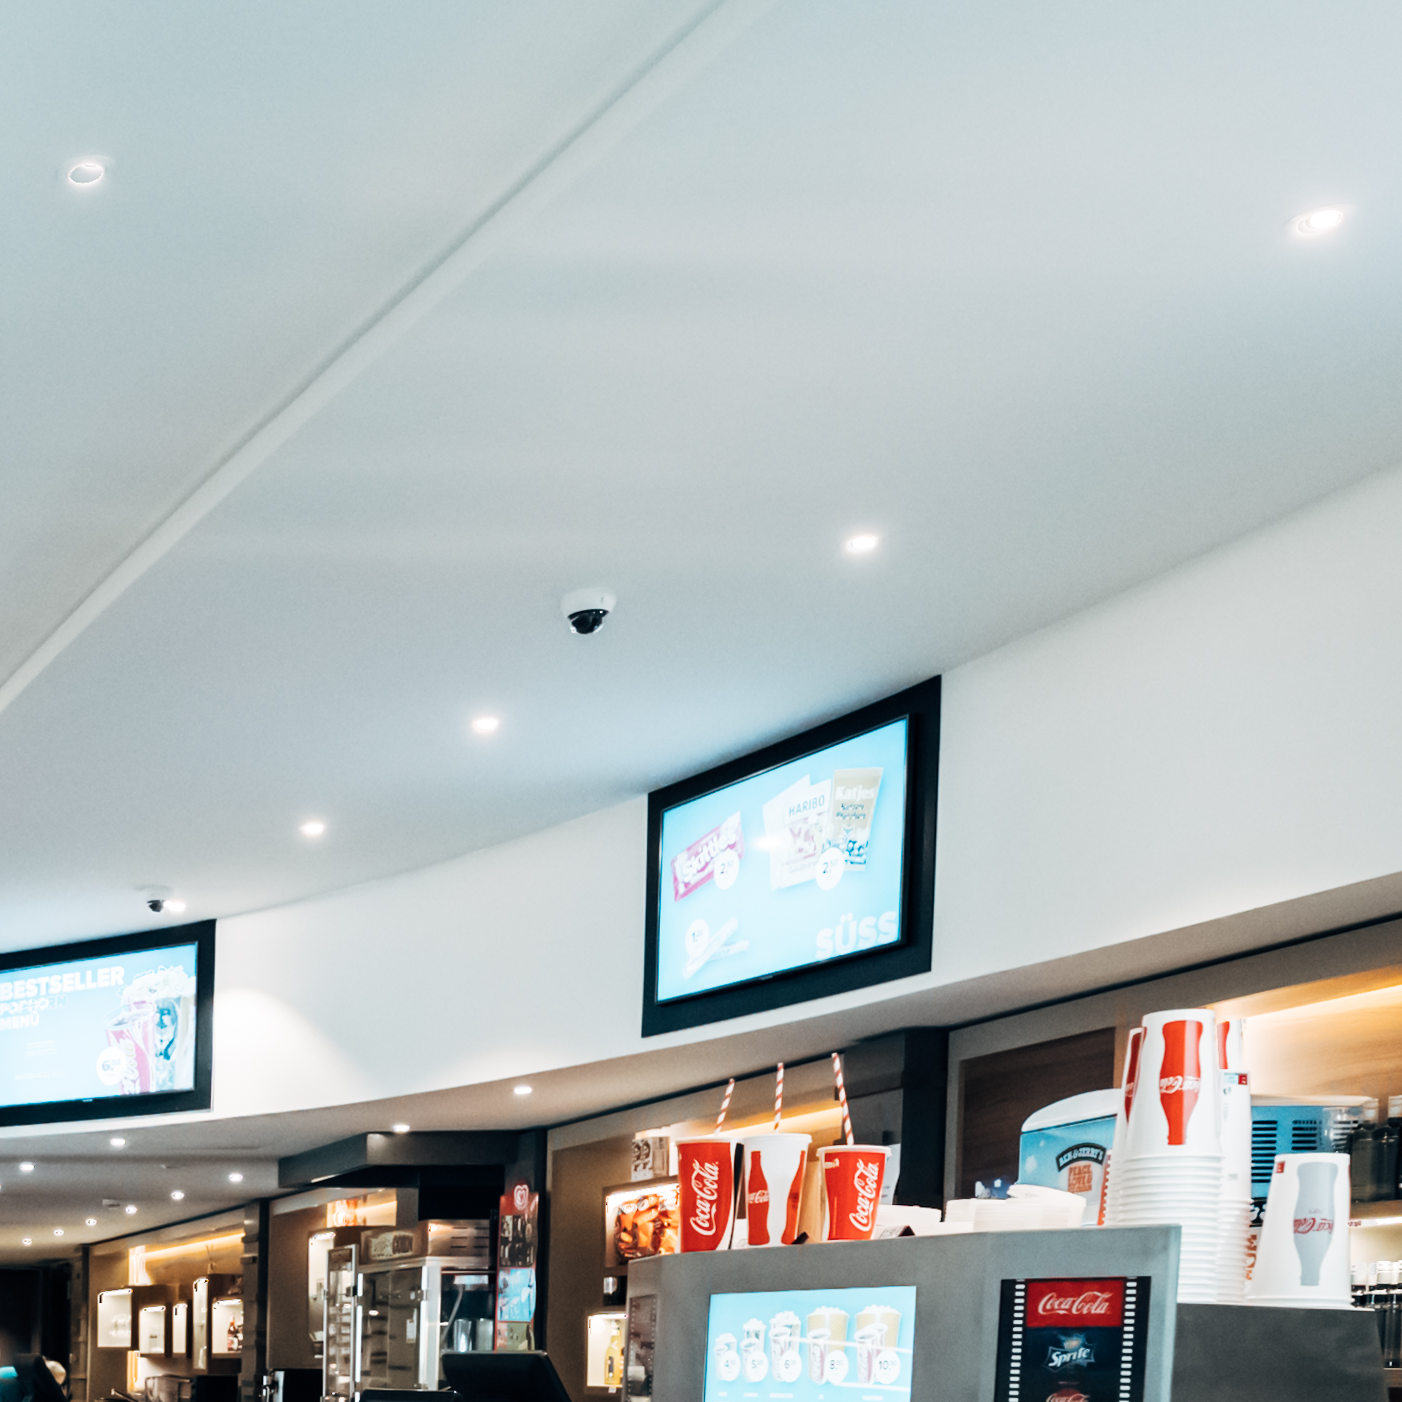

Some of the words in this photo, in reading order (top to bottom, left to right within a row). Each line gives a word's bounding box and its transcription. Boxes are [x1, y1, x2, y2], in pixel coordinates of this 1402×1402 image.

[788, 794, 825, 817] HARIBO
[815, 911, 898, 959] SÜSS
[0, 966, 125, 1001] BESTSELLER
[0, 1010, 40, 1031] MENÜ
[690, 1158, 720, 1236] Coca-Cola
[849, 1158, 879, 1232] Coca-Cola
[1038, 1291, 1113, 1315] Coca-Cola
[1048, 1347, 1091, 1368] Sprite
